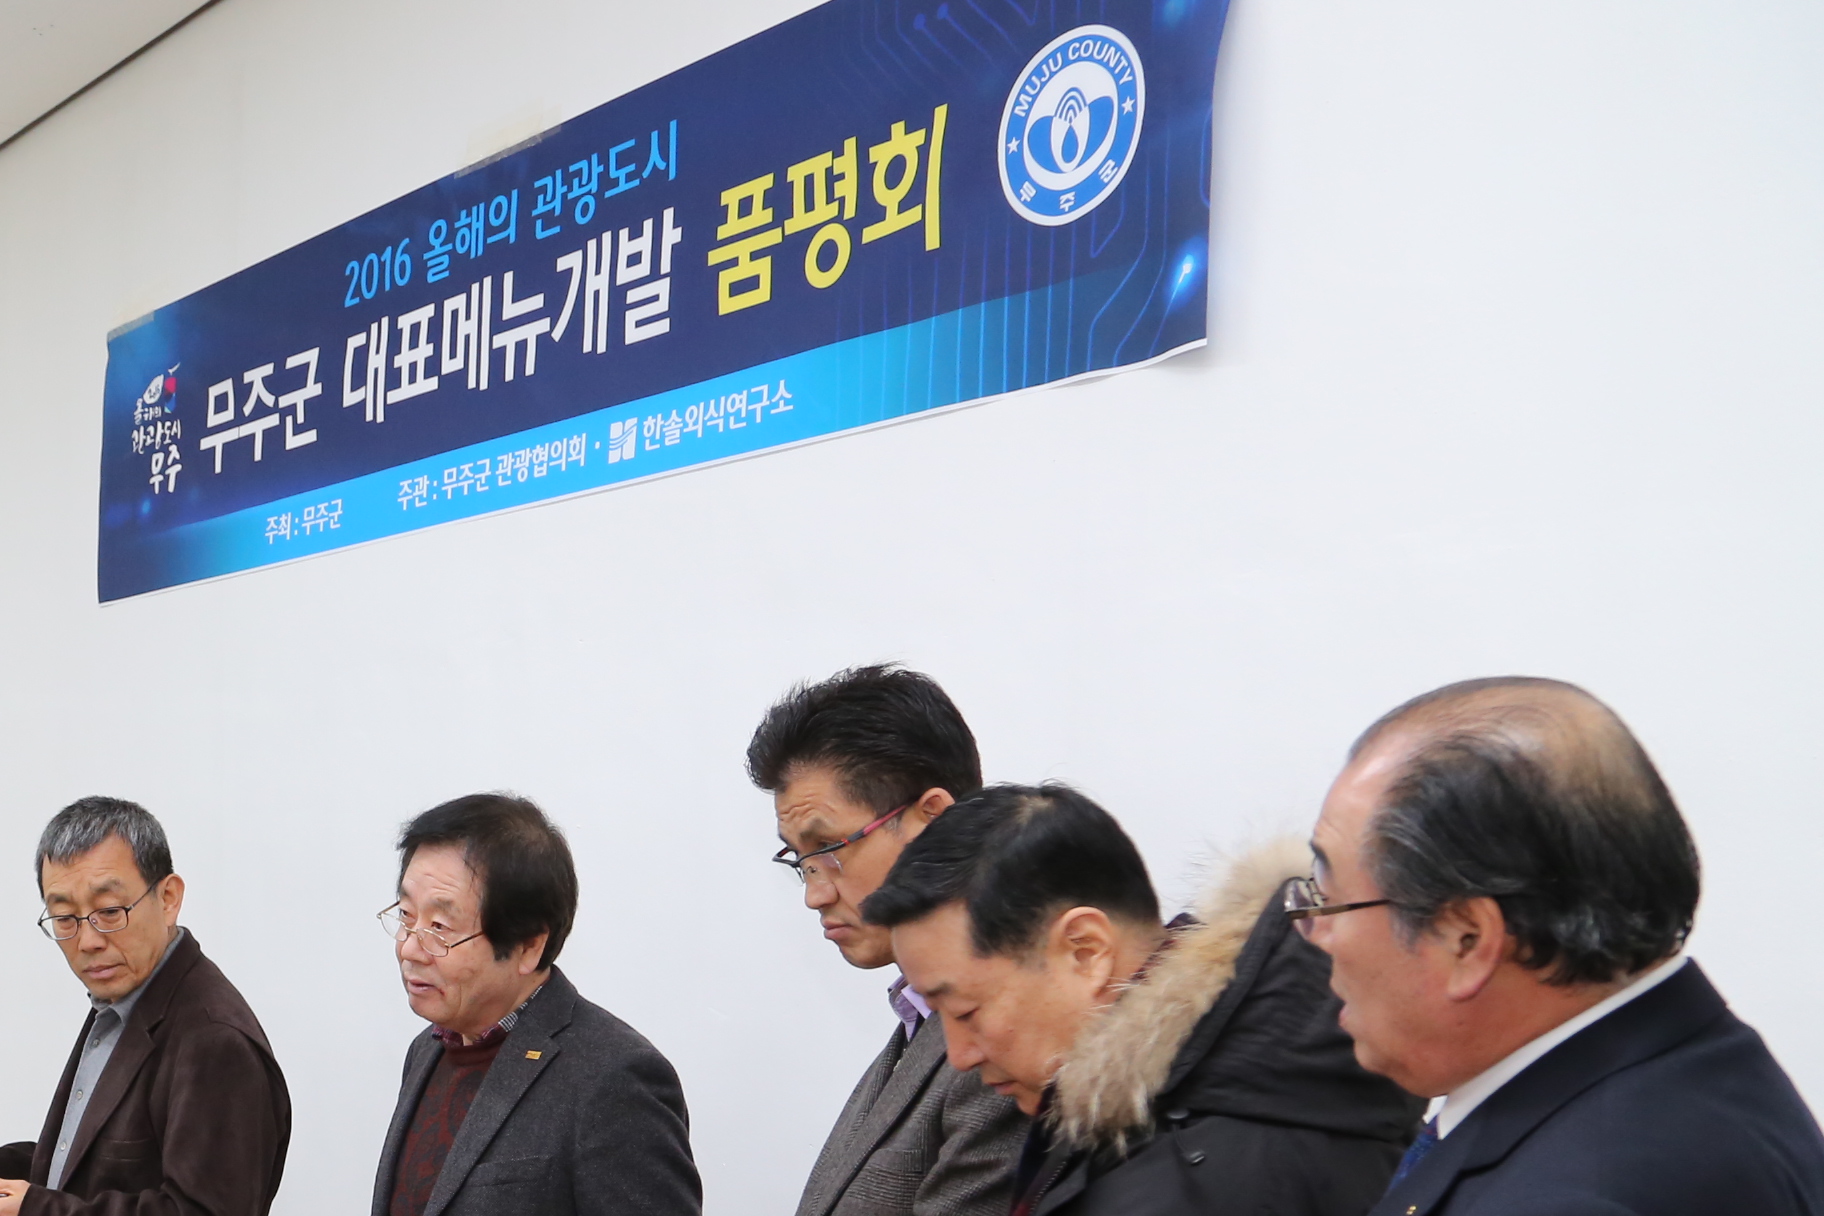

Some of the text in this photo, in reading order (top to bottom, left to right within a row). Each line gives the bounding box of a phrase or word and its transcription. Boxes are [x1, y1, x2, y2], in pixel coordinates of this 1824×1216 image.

[1014, 39, 1133, 117] MUJU COUNTY
[344, 119, 677, 308] 2016 올해의 관광도시
[199, 103, 949, 475] 무주군 대표메뉴개발 품평회
[131, 419, 182, 454] 관광도시
[149, 444, 183, 495] 무주
[441, 458, 492, 500] 무주군
[495, 432, 587, 487] 관광협의회
[642, 379, 794, 451] 한솔외식연구소
[301, 498, 344, 536] 무주군
